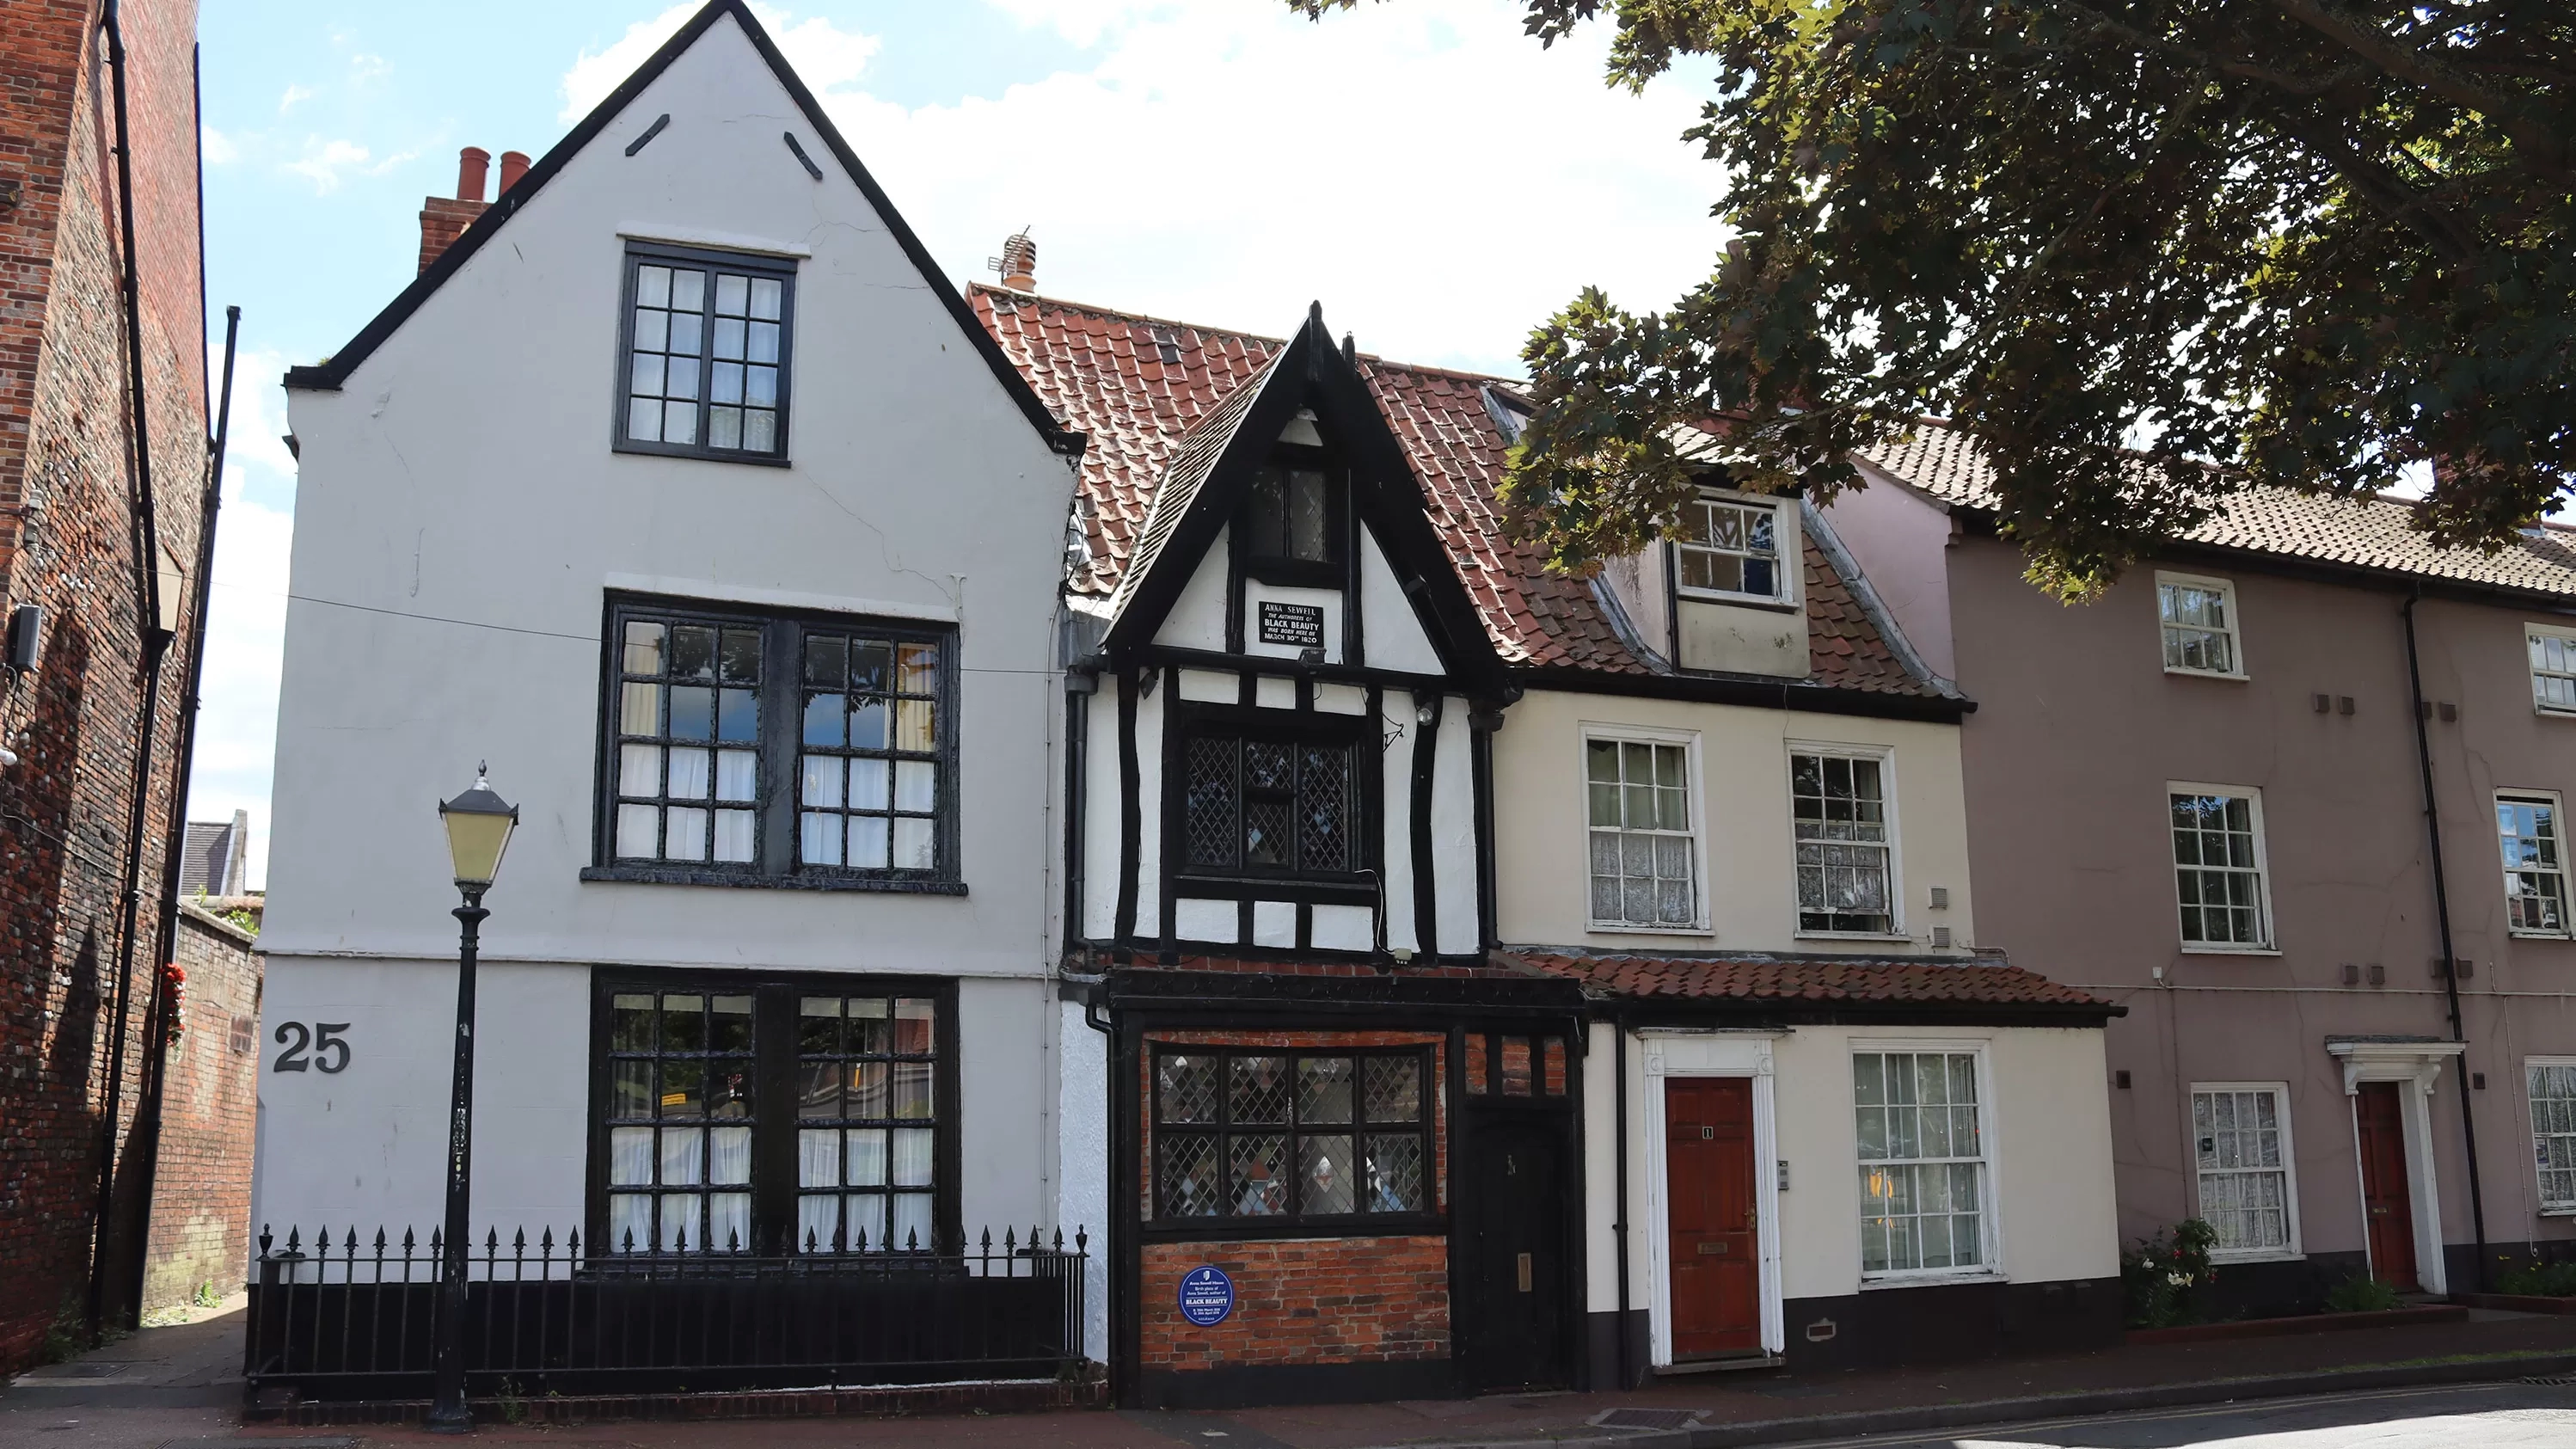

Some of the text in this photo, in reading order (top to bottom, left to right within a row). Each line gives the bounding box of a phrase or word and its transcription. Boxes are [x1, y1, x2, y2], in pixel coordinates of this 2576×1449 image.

[1265, 604, 1282, 612] ANNA
[1265, 618, 1319, 630] BLACK BEAUTY
[273, 1021, 351, 1073] 25
